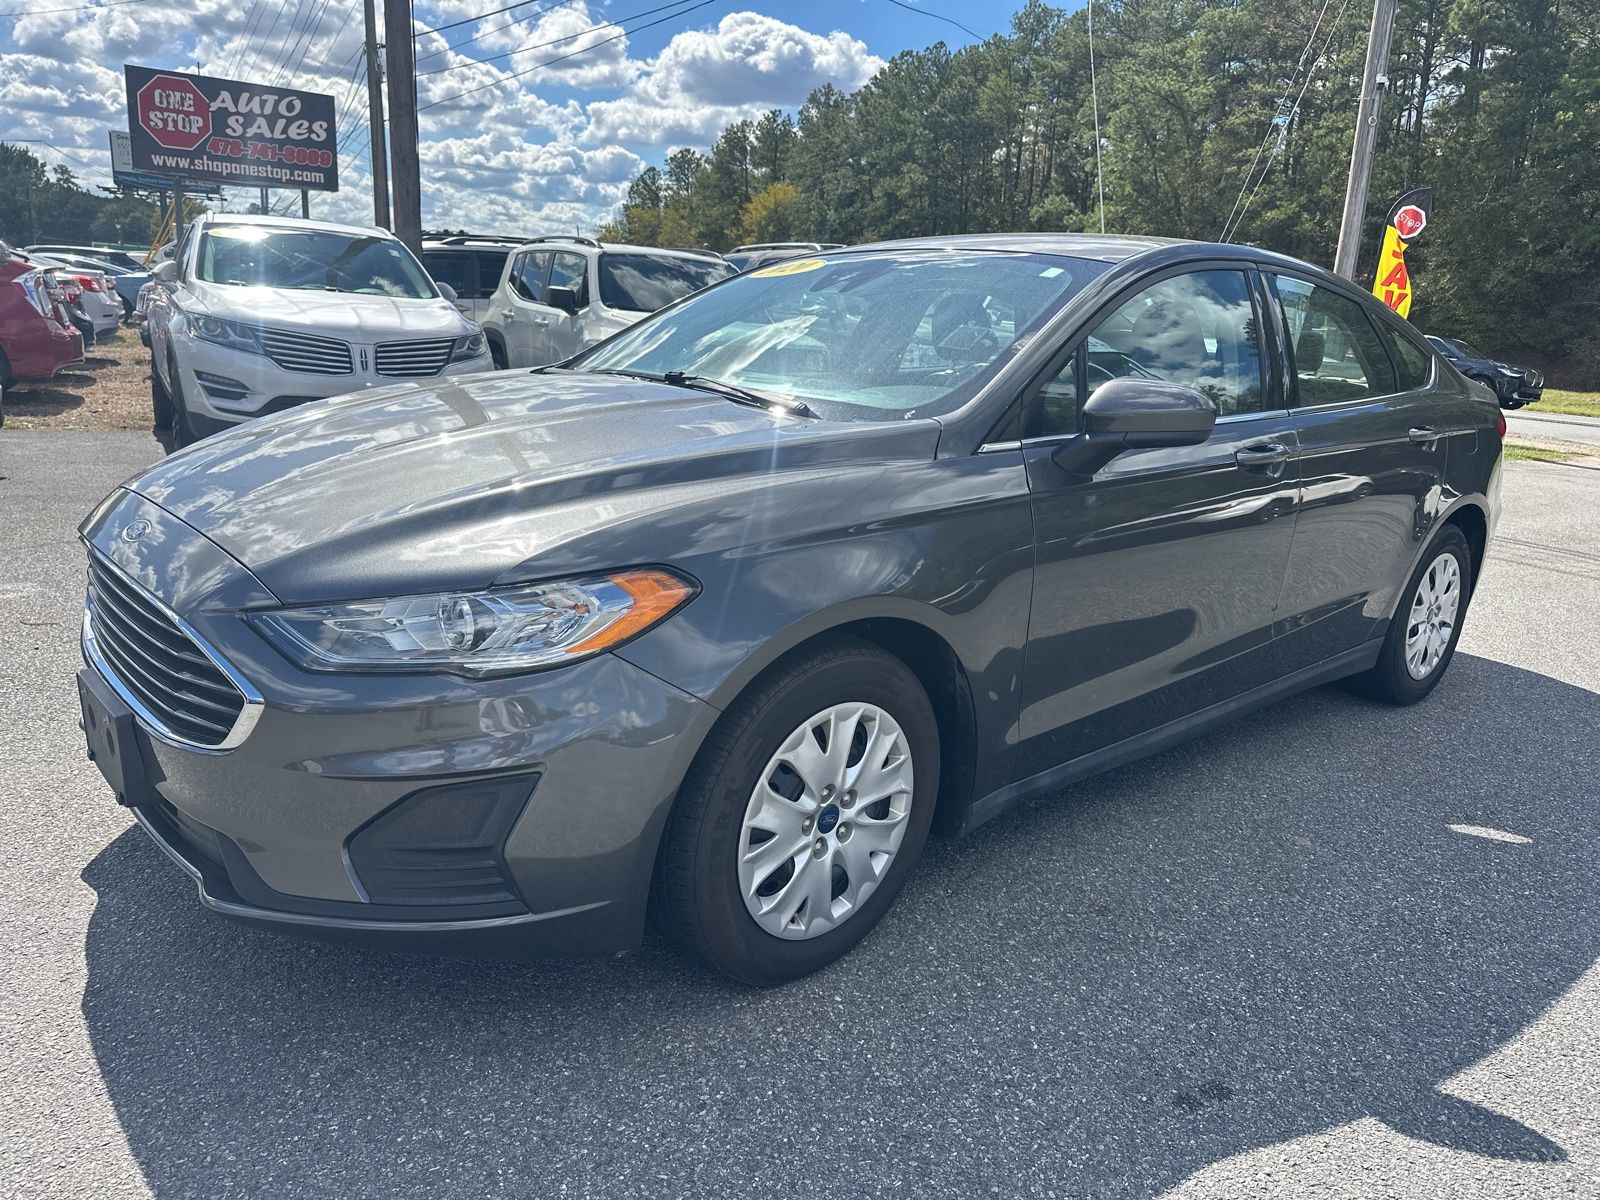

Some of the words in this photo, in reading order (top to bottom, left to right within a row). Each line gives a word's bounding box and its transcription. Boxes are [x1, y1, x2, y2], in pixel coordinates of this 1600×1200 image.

[154, 89, 195, 112] ONE
[208, 90, 302, 117] AUTO
[149, 110, 204, 134] STOP
[151, 154, 325, 184] www.shoponestop.com
[1398, 213, 1421, 229] STOP
